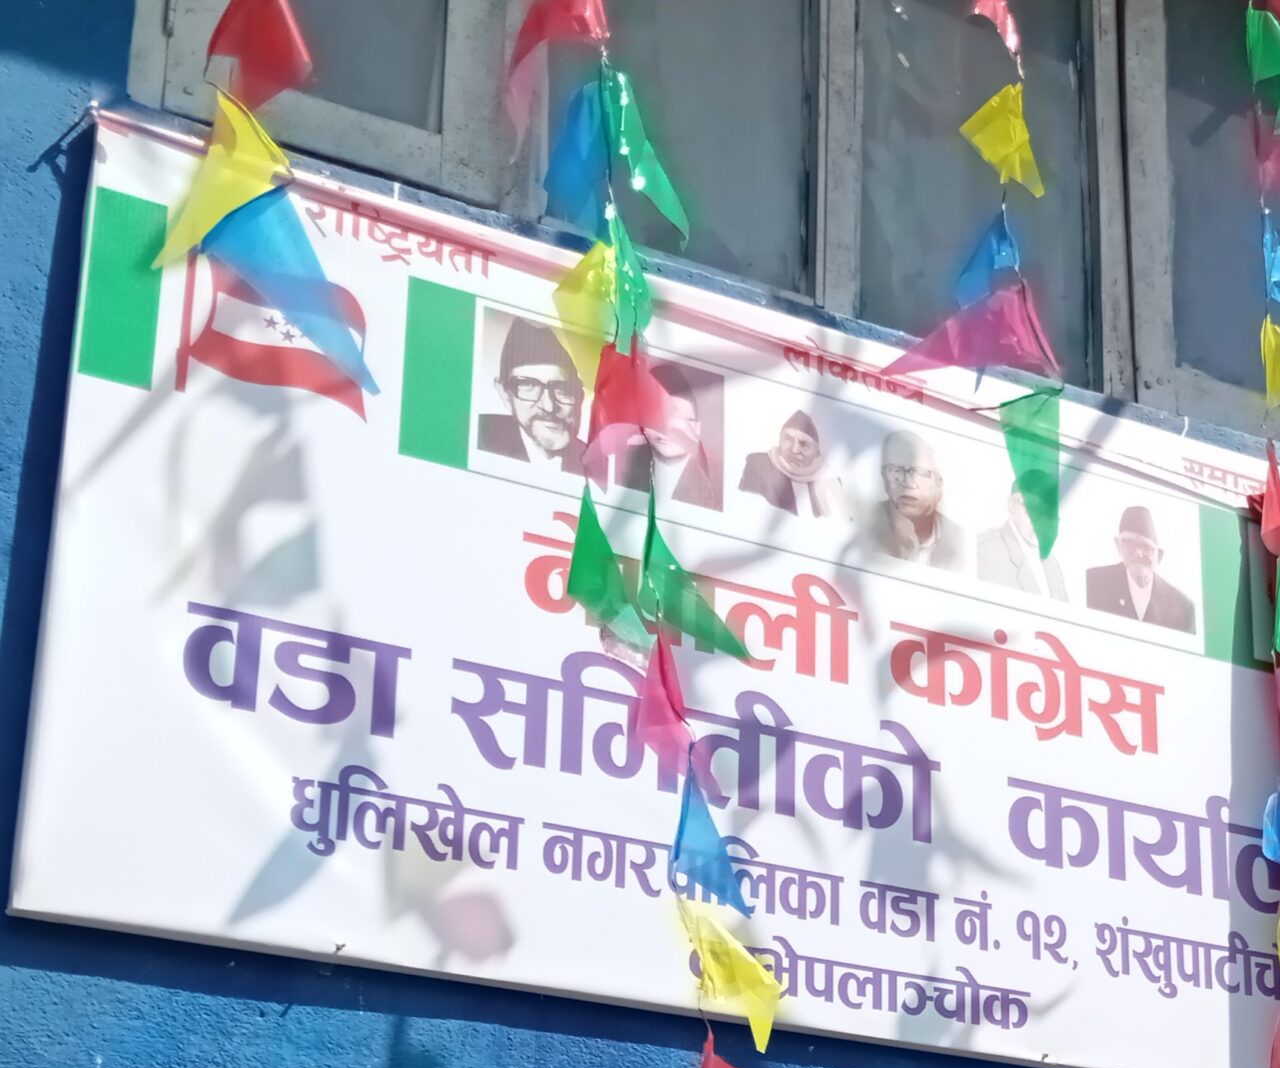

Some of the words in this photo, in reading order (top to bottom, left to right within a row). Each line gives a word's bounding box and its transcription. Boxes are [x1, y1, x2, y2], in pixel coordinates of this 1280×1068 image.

[183, 601, 412, 739] वडा
[451, 650, 941, 845] समितीको
[890, 620, 1165, 756] कांग्रेस
[290, 764, 525, 872] धुलिखेल
[542, 822, 844, 926] नगरपालिका
[859, 879, 939, 942] वडा
[954, 890, 1000, 953] नं.
[689, 936, 1031, 1031] भ्रेपलाञ्चोक
